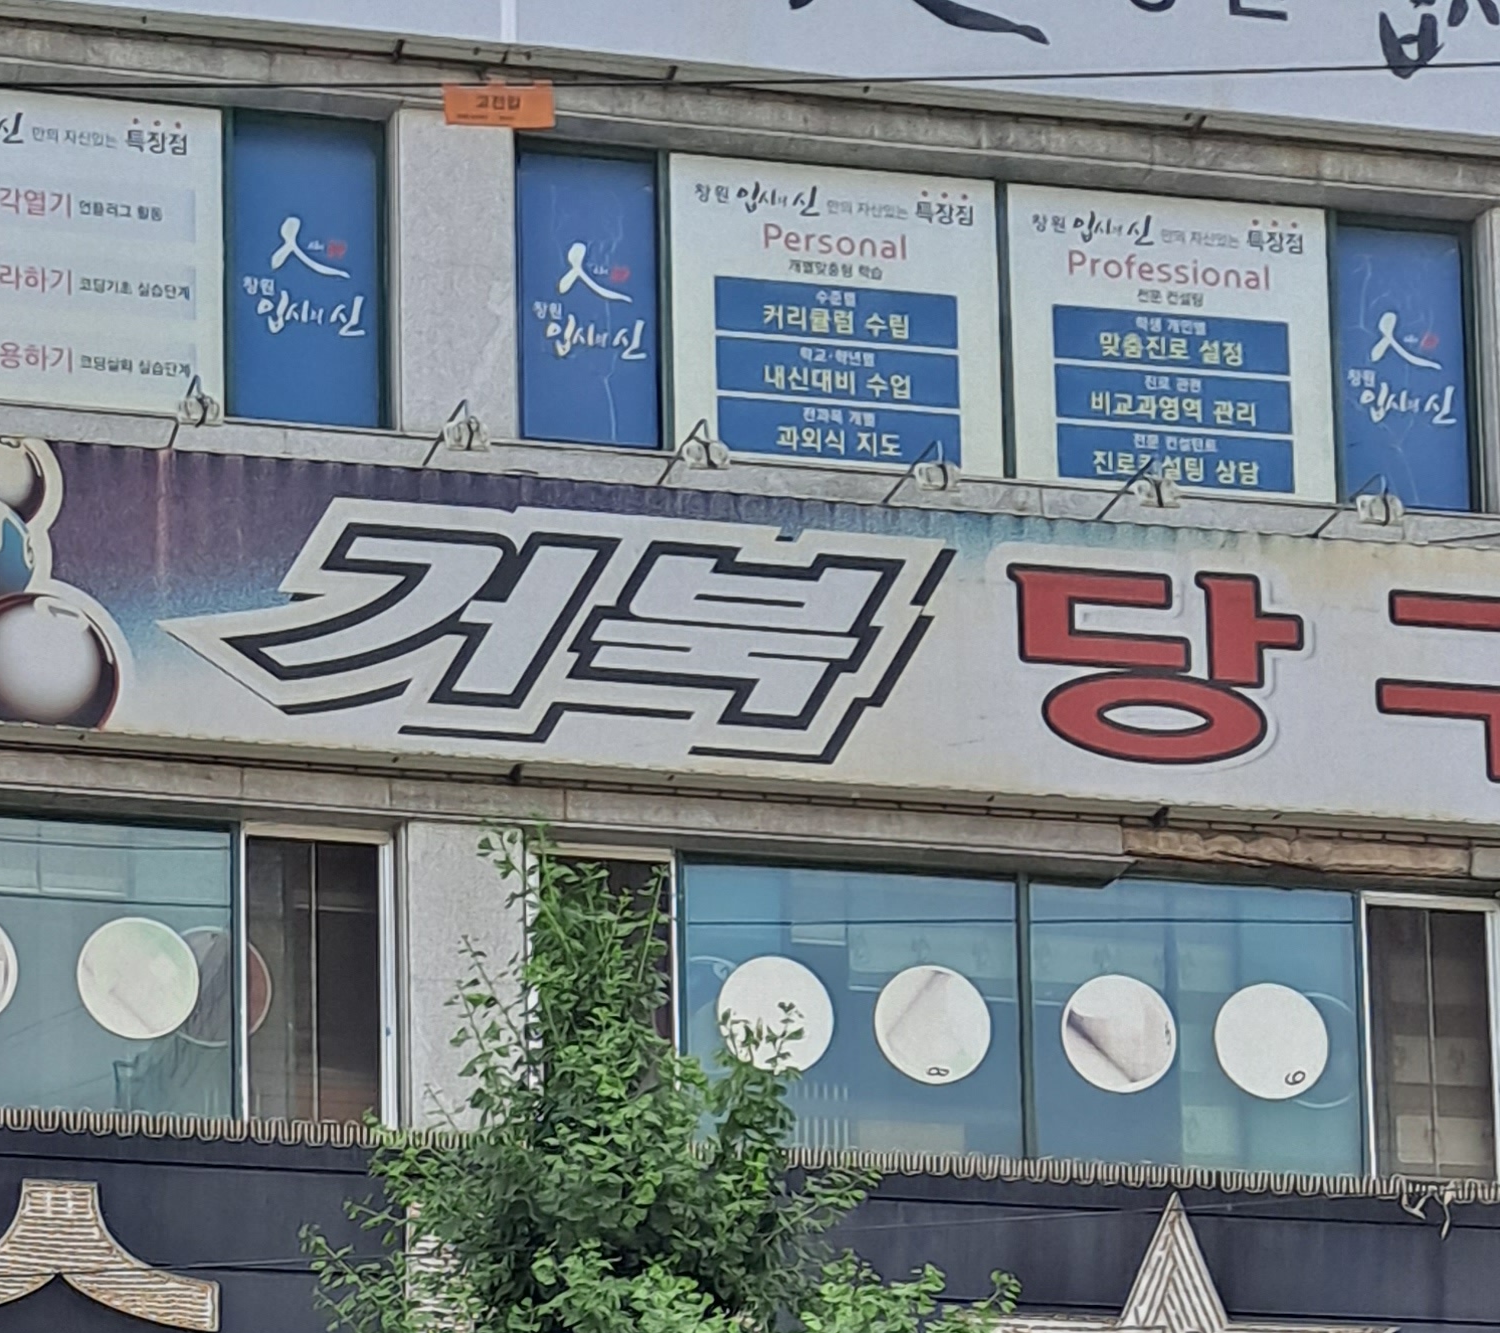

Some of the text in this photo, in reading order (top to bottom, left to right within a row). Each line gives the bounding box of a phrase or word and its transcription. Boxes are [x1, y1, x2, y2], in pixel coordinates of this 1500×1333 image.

[124, 129, 188, 155] 특장점
[792, 186, 820, 217] 신
[915, 202, 974, 226] 특장점
[762, 223, 908, 260] Personal
[1127, 214, 1154, 246] 신
[1247, 230, 1304, 255] 특장점
[1068, 250, 1271, 291] Professional
[330, 296, 366, 337] 신
[763, 304, 910, 340] 커리큘럼 수립
[612, 320, 648, 361] 신
[1100, 332, 1244, 367] 맞춤진로 설정
[764, 364, 911, 400] 내신대비 수업
[1090, 391, 1256, 427] 비교과영역 관리
[1424, 385, 1458, 425] 신
[776, 426, 903, 458] 과외식 지도
[1215, 460, 1259, 485] 상담
[215, 505, 953, 765] 거북
